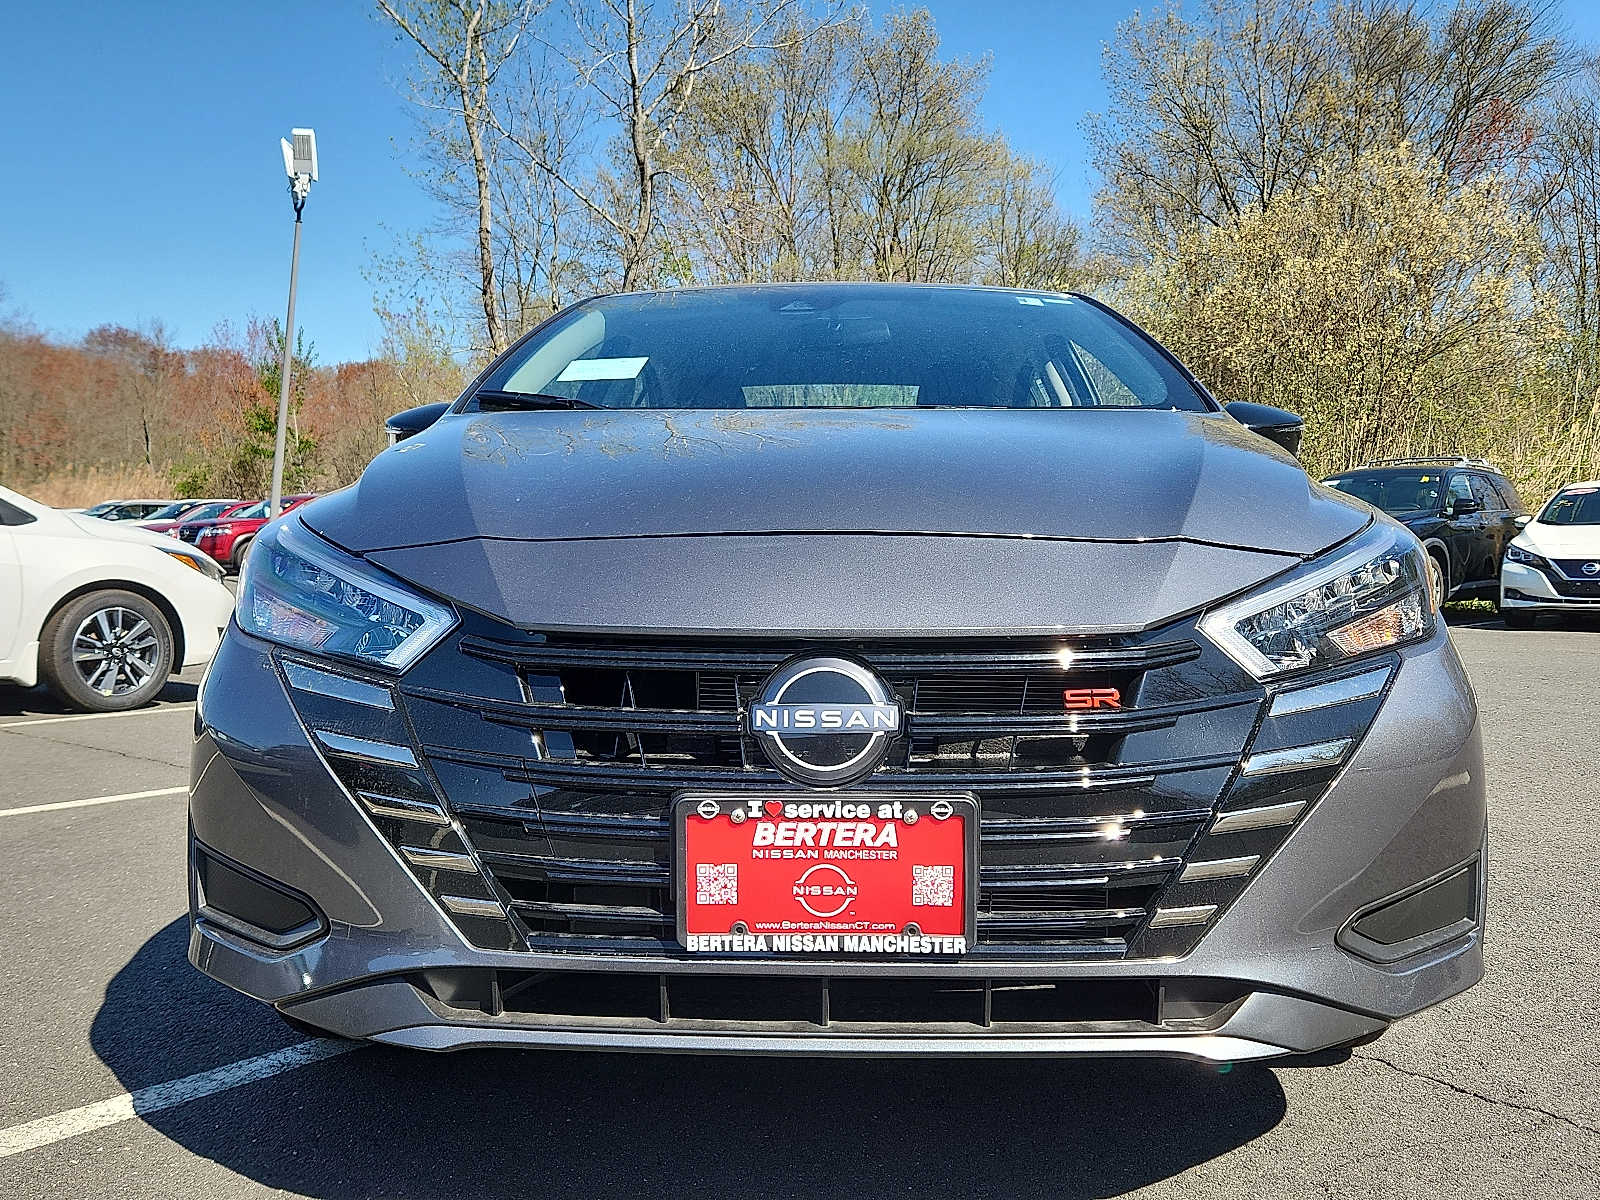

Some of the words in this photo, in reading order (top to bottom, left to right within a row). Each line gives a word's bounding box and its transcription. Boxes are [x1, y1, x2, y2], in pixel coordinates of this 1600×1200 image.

[1063, 687, 1121, 709] SR
[755, 708, 897, 728] NISSAN
[747, 800, 763, 818] I
[784, 801, 870, 819] service
[877, 801, 903, 819] at
[752, 822, 898, 847] BERTERA
[752, 850, 820, 859] NISSAN
[823, 850, 897, 860] MANCHESTER
[792, 886, 858, 896] NISSAN
[755, 921, 896, 931] www.BerteraNissanCT.com
[686, 936, 770, 952] BERTERA
[773, 936, 841, 952] NISSAN
[847, 937, 967, 954] MANCHESTER
